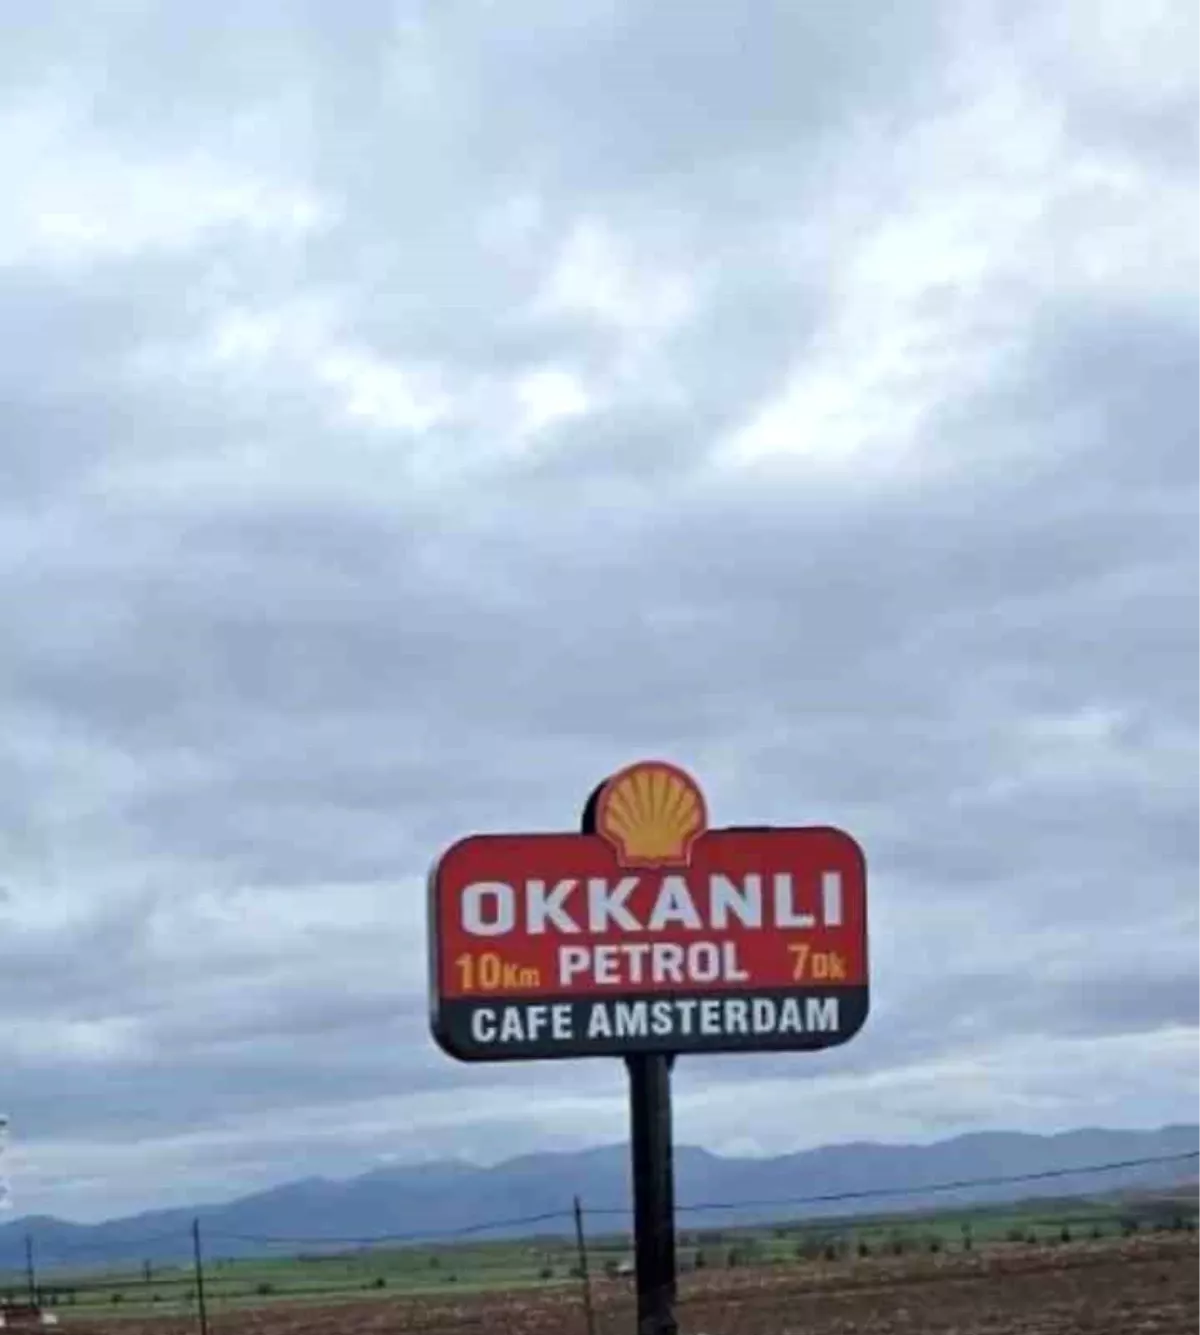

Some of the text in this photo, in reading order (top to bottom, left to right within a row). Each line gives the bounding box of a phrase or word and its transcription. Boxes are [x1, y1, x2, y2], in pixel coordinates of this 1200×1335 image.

[462, 872, 842, 935] OKKANLI
[559, 942, 749, 986] PETROL
[472, 998, 839, 1042] CAFE AMSTERDAM
